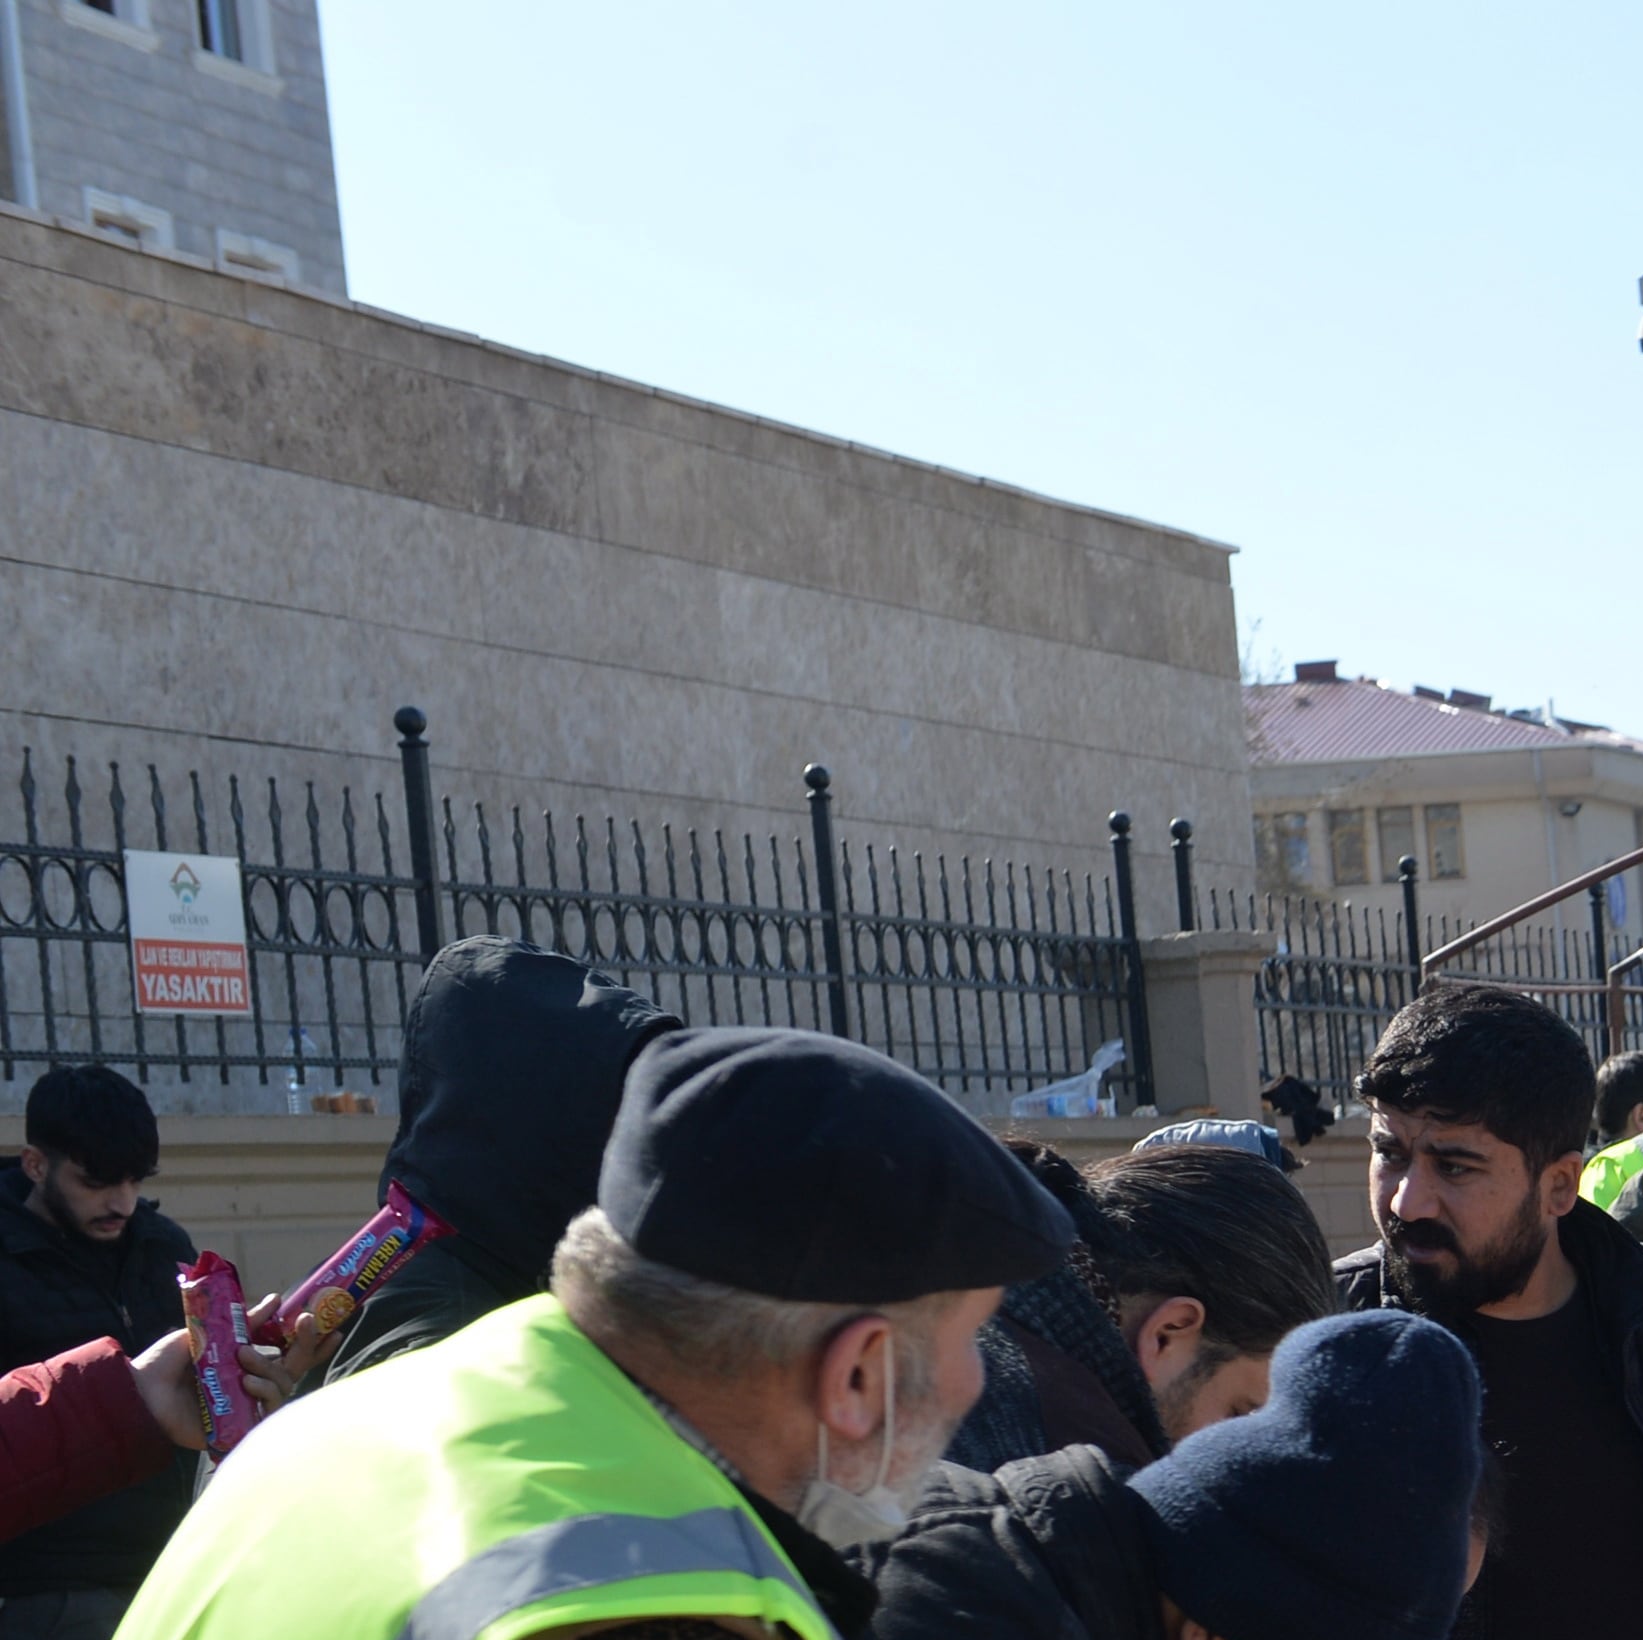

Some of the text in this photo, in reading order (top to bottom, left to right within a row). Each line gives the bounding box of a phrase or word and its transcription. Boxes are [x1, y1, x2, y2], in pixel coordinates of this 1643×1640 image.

[141, 973, 245, 1005] YASAKTIR
[338, 1232, 376, 1276] Rondo
[354, 1233, 402, 1291] KREMALI
